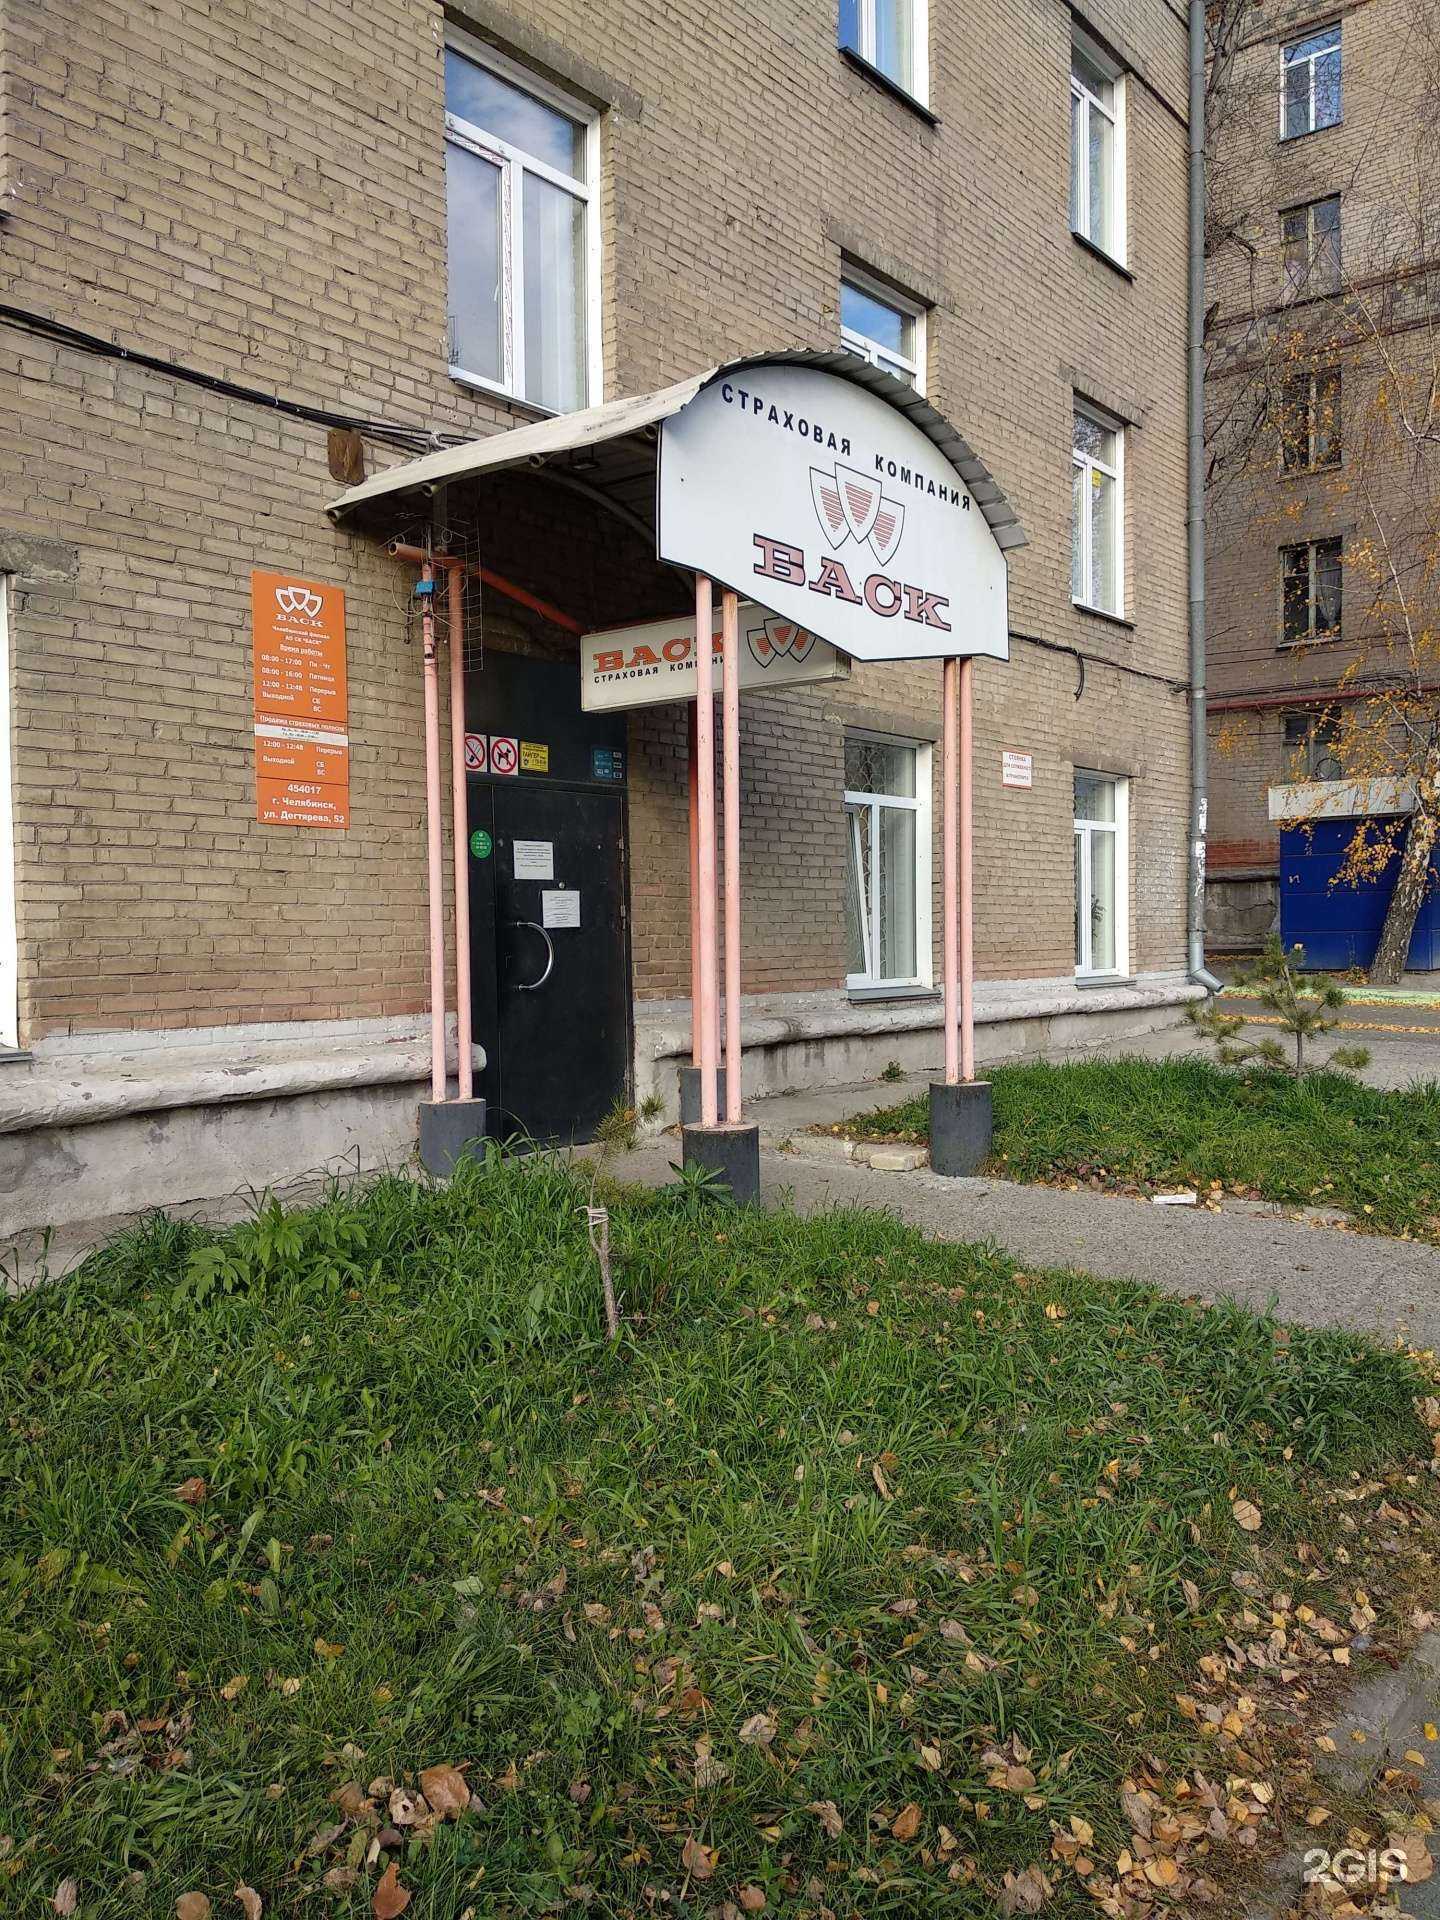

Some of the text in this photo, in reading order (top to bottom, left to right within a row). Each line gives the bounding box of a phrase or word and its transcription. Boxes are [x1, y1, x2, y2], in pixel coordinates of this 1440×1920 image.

[721, 383, 971, 511] СТРАХОВАЯ КОМПАНИЯ
[753, 532, 952, 633] БАСК
[276, 614, 324, 627] БАСК
[279, 644, 323, 657] Время работы
[261, 654, 280, 663] 08:00
[285, 658, 302, 666] 17:00
[261, 667, 280, 676] 08:00
[285, 670, 303, 679] 16:00
[309, 672, 335, 682] Пятница
[594, 666, 659, 684] СТРАХОВАЯ
[262, 680, 280, 688] 12:00
[286, 683, 303, 691] 12:48
[309, 686, 336, 696] Перерыв
[262, 691, 295, 701] Выходной
[260, 715, 288, 725] Продажа
[263, 740, 280, 748] 12:00
[286, 743, 304, 751] 12:48
[316, 746, 343, 755] Перерыв
[263, 755, 295, 765] Выходной
[287, 784, 321, 794] 454017
[282, 797, 336, 810] Челябинск,
[263, 811, 345, 824] ул. Дегтярева, 52
